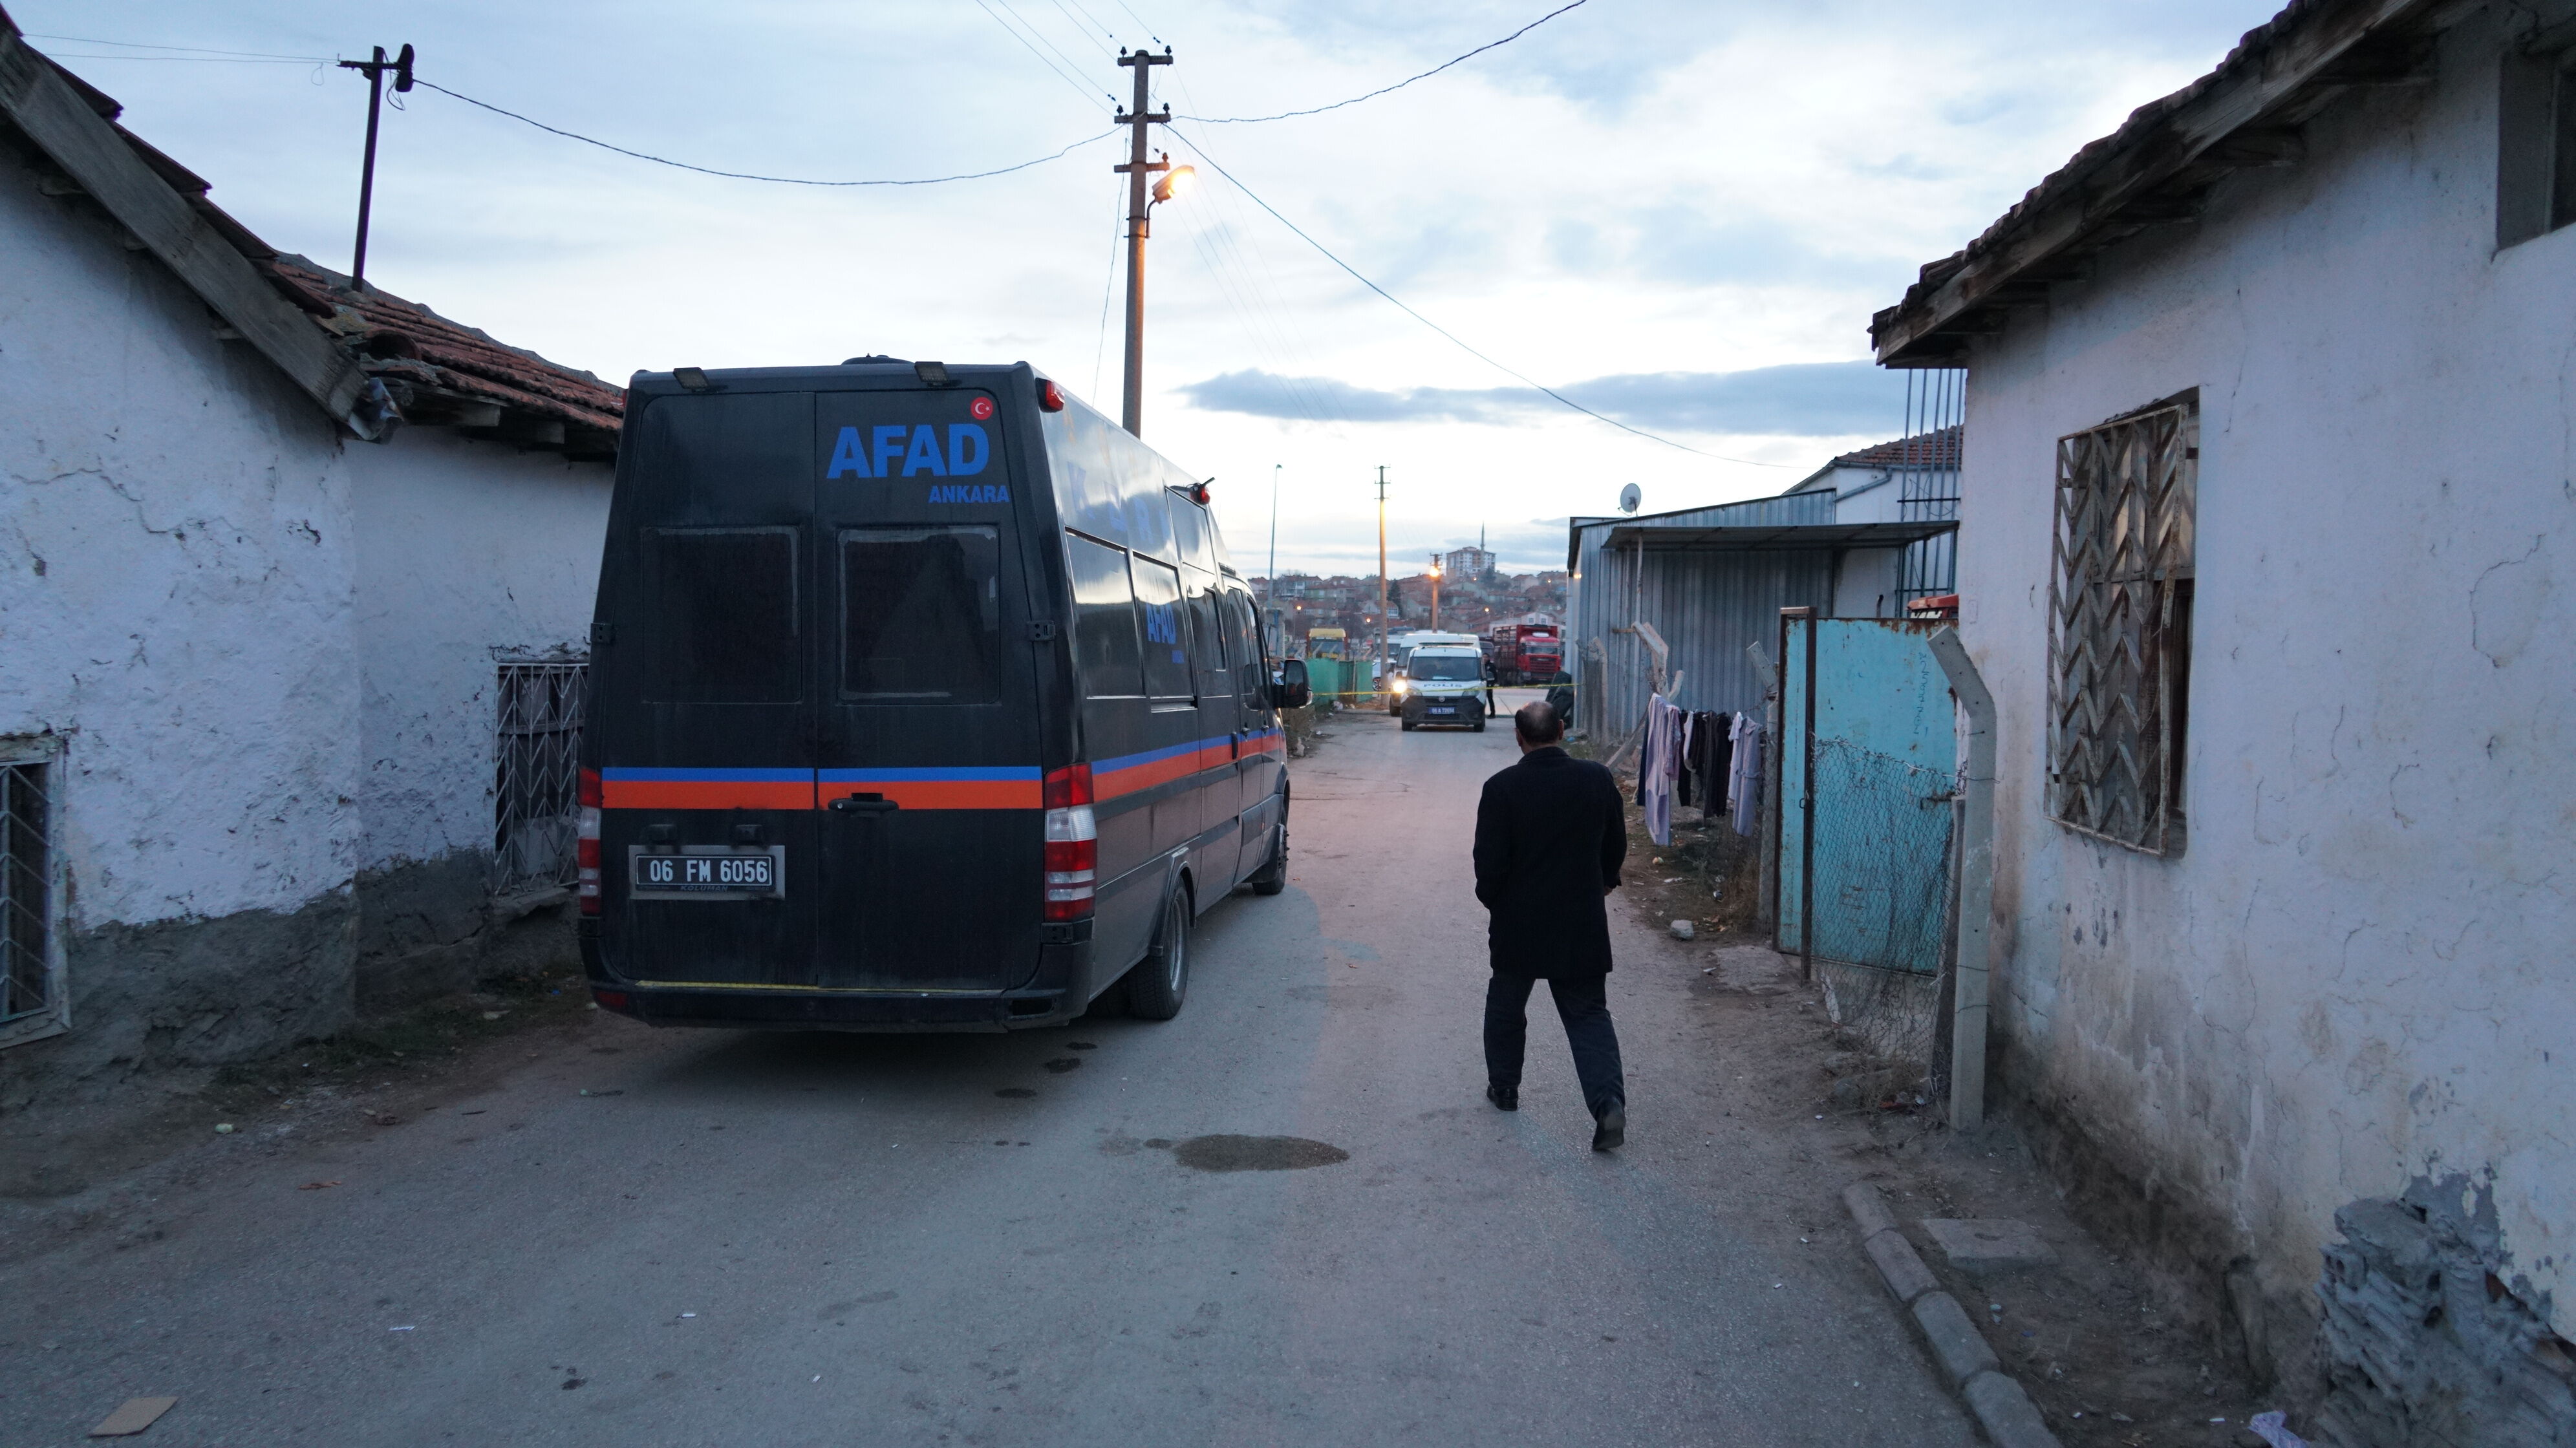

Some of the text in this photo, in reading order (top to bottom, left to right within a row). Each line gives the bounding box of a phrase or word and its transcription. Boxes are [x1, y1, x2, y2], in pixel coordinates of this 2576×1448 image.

[827, 423, 989, 479] AFAD
[928, 485, 1010, 504] ANKARA
[650, 860, 767, 883] 06 FM 6056
